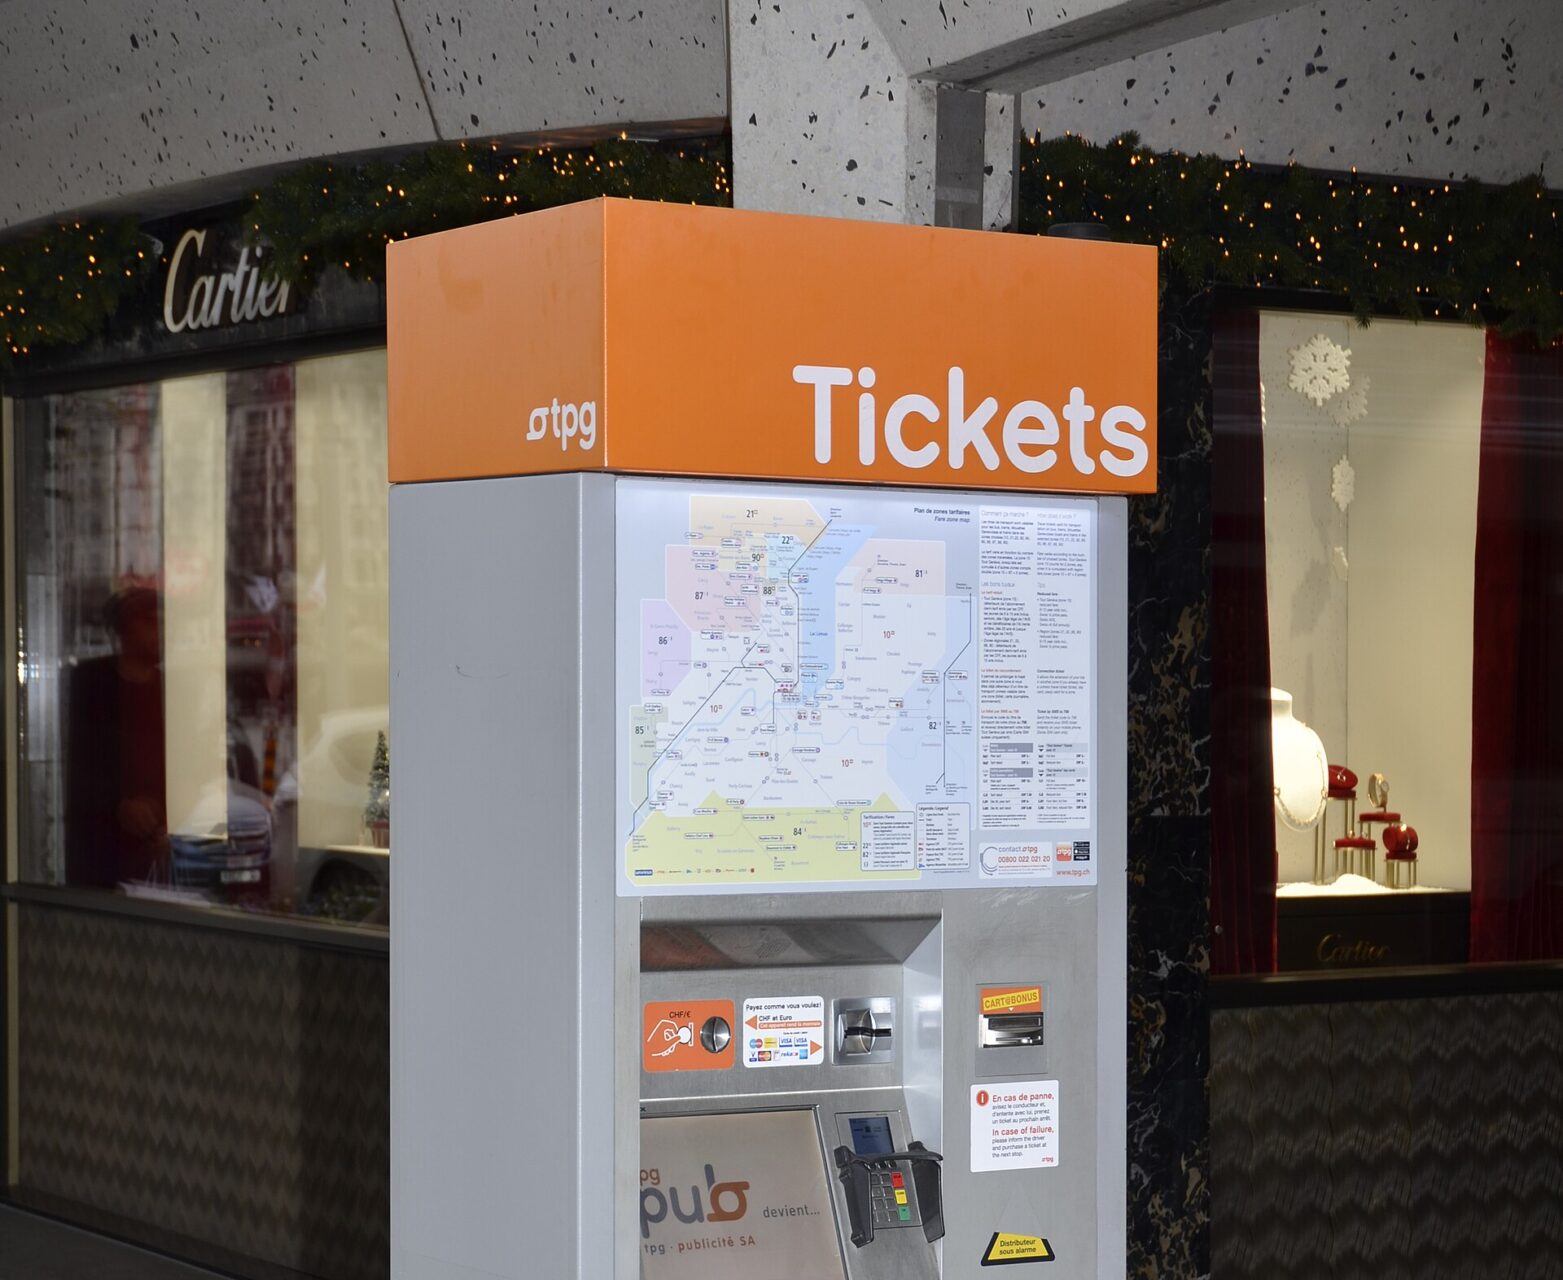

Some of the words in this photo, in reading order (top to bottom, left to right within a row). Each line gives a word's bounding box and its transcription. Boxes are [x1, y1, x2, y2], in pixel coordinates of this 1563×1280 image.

[164, 229, 290, 333] Cartier
[792, 365, 1149, 478] Tickets
[746, 510, 755, 518] 21
[781, 536, 790, 544] 22
[752, 553, 760, 562] 90
[915, 570, 923, 578] 81
[763, 586, 772, 595] 88
[695, 592, 704, 600] 87
[883, 630, 891, 639] 10
[658, 636, 668, 645] 86
[710, 705, 719, 713] 10
[928, 721, 937, 730] 82
[635, 726, 644, 735] 85
[842, 759, 849, 767] 10
[793, 827, 802, 836] 84
[1030, 855, 1041, 863] 021
[1042, 855, 1051, 863] 20
[1056, 868, 1090, 877] www.tpg.ch
[1317, 934, 1391, 962] Cartier
[745, 1004, 763, 1012] Payez
[669, 1010, 691, 1019] CHF/€
[992, 1095, 1002, 1103] En
[1018, 1093, 1028, 1101] de
[1030, 1093, 1055, 1103] panne,
[992, 1128, 999, 1136] In
[1001, 1128, 1019, 1136] case
[1020, 1126, 1028, 1135] of
[1029, 1125, 1055, 1134] failure,
[763, 1205, 820, 1218] devient...
[644, 1244, 666, 1255] tpg
[678, 1236, 735, 1253] publicité
[740, 1235, 756, 1246] SA
[1000, 1239, 1036, 1247] Distributeur
